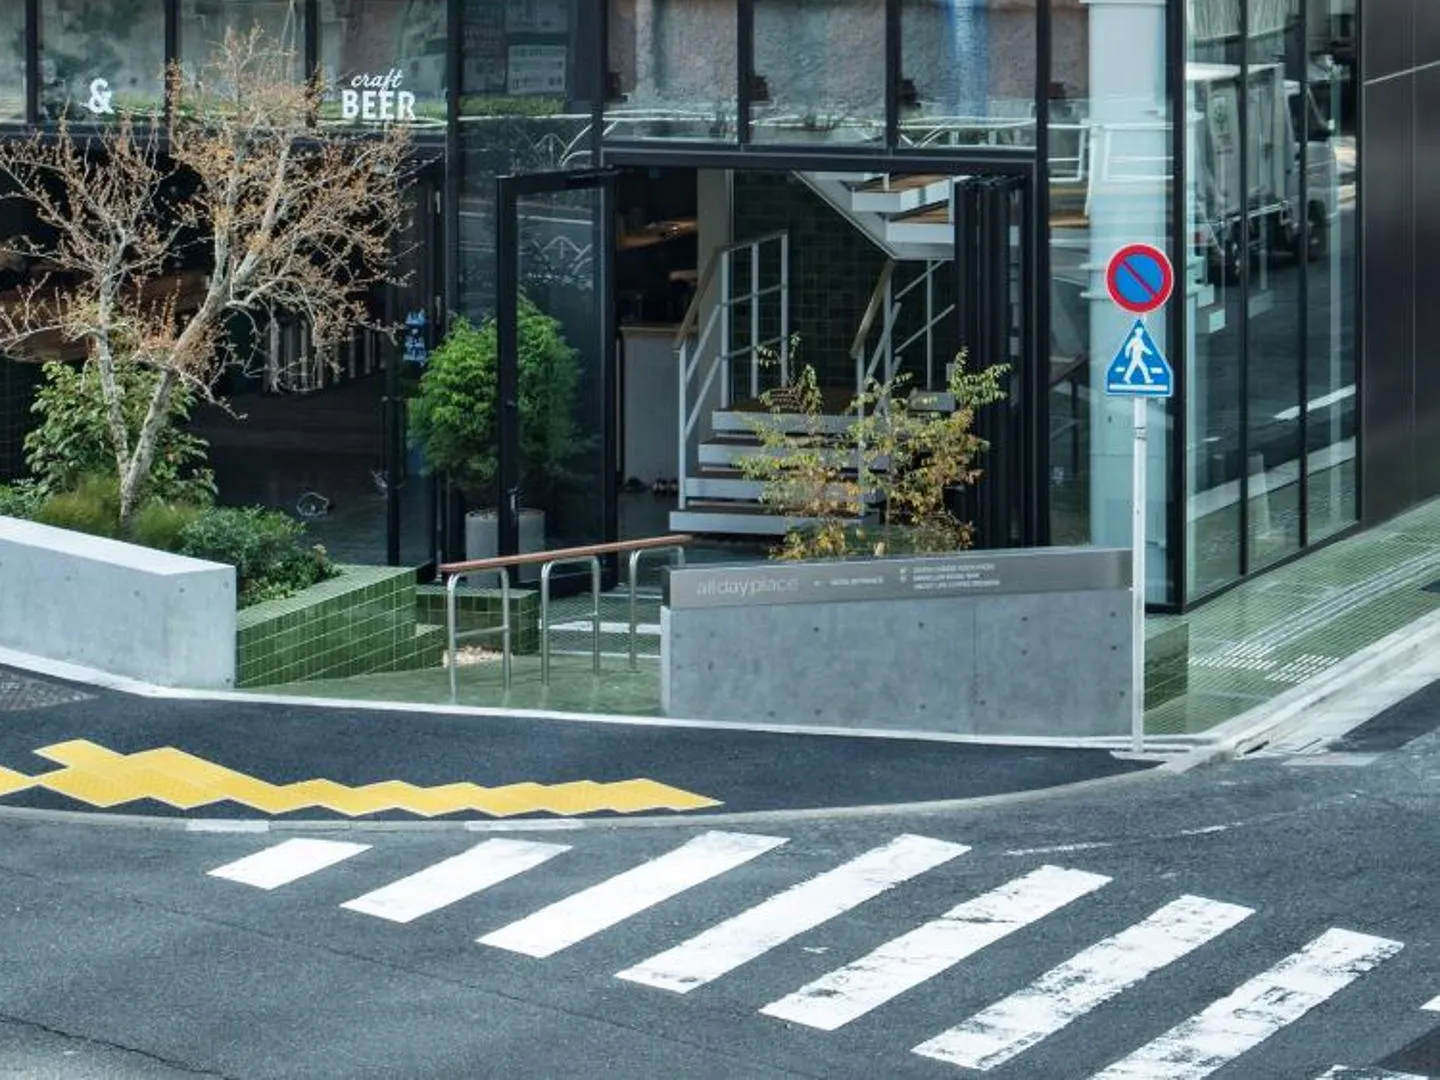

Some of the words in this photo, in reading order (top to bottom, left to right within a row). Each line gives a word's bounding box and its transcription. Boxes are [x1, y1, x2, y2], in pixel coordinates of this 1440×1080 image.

[350, 68, 404, 93] craft
[89, 78, 115, 114] &
[342, 89, 416, 121] BEER
